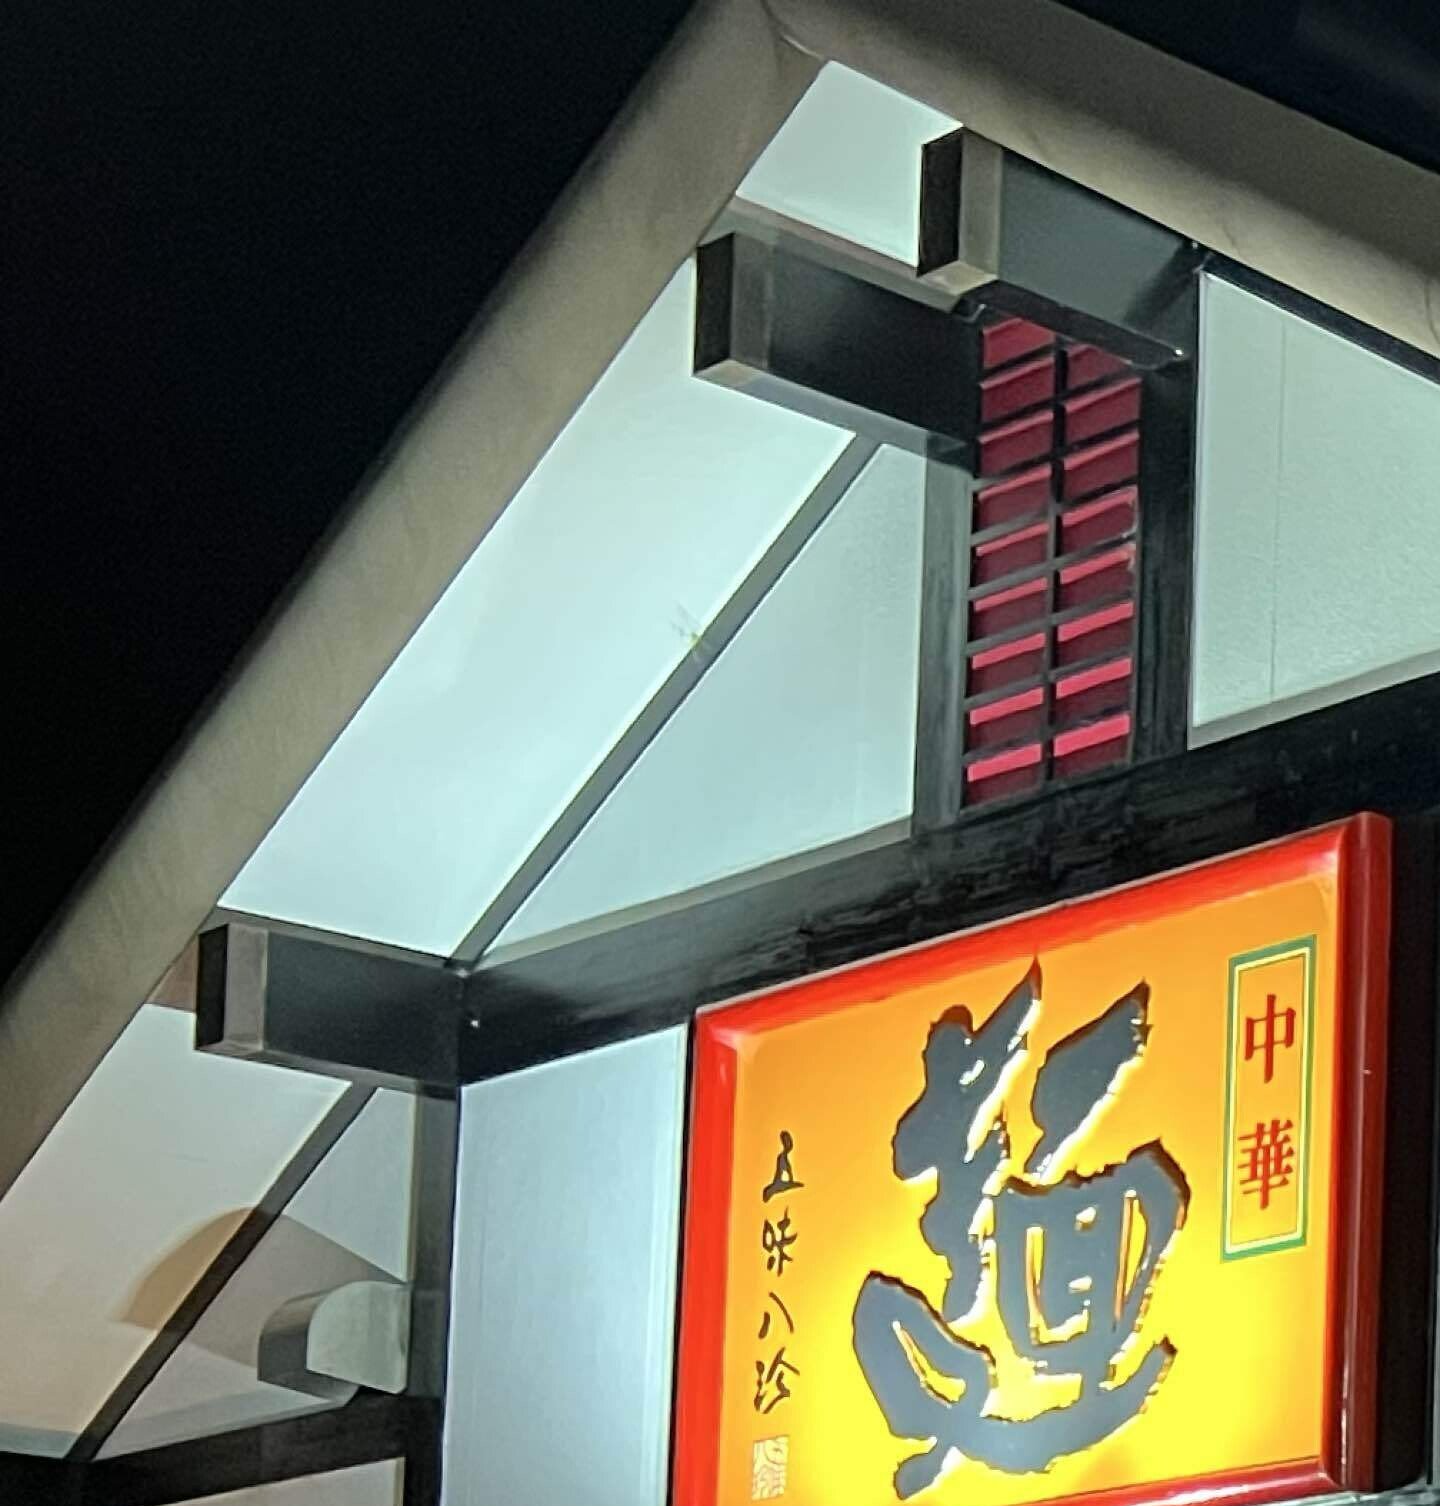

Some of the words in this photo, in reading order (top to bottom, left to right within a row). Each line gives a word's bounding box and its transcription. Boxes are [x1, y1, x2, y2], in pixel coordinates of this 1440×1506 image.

[1237, 992, 1297, 1211] 中華
[754, 1130, 805, 1415] 五味八珍
